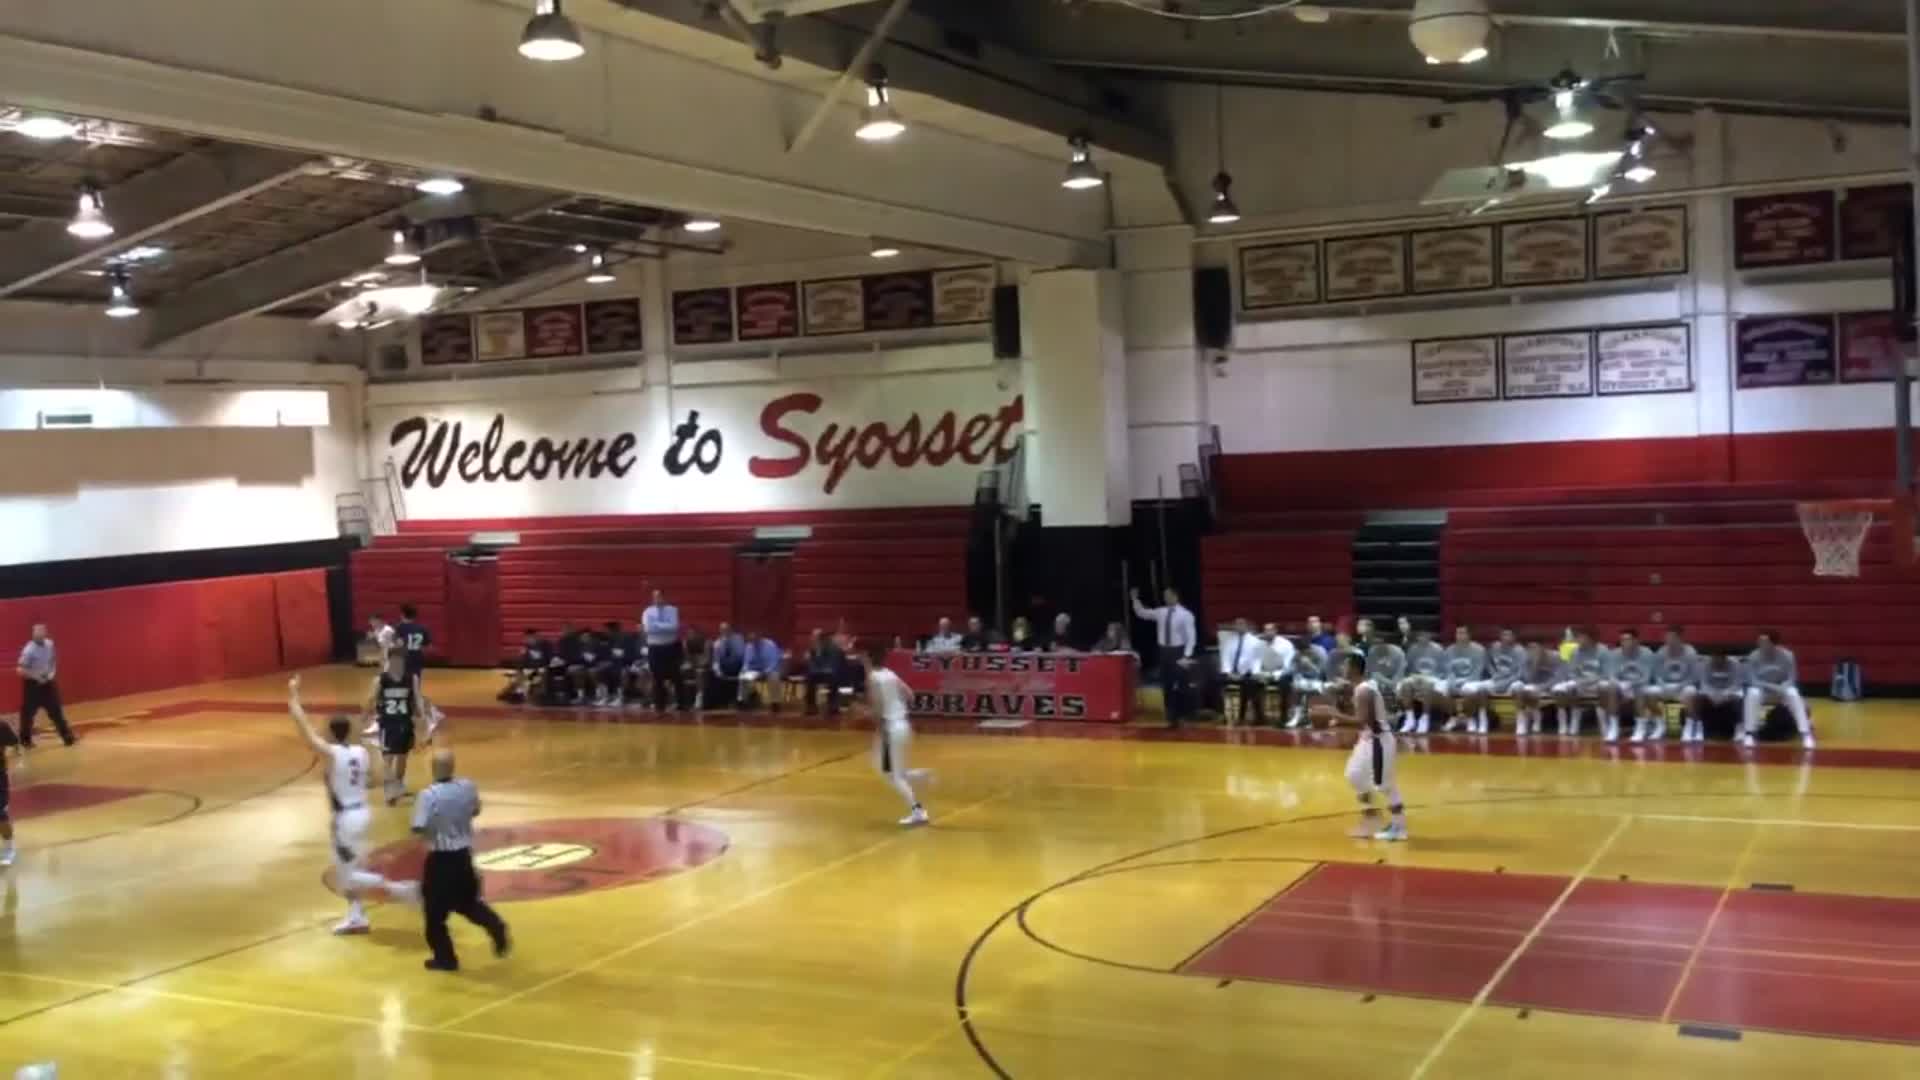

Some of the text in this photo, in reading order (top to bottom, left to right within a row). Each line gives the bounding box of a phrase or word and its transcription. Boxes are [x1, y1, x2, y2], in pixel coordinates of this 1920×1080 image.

[390, 393, 1024, 495] Welcome to Syosset
[407, 633, 423, 650] 12
[911, 655, 1082, 673] SYOSSET
[385, 699, 407, 715] 24
[909, 690, 1087, 717] BRAVES
